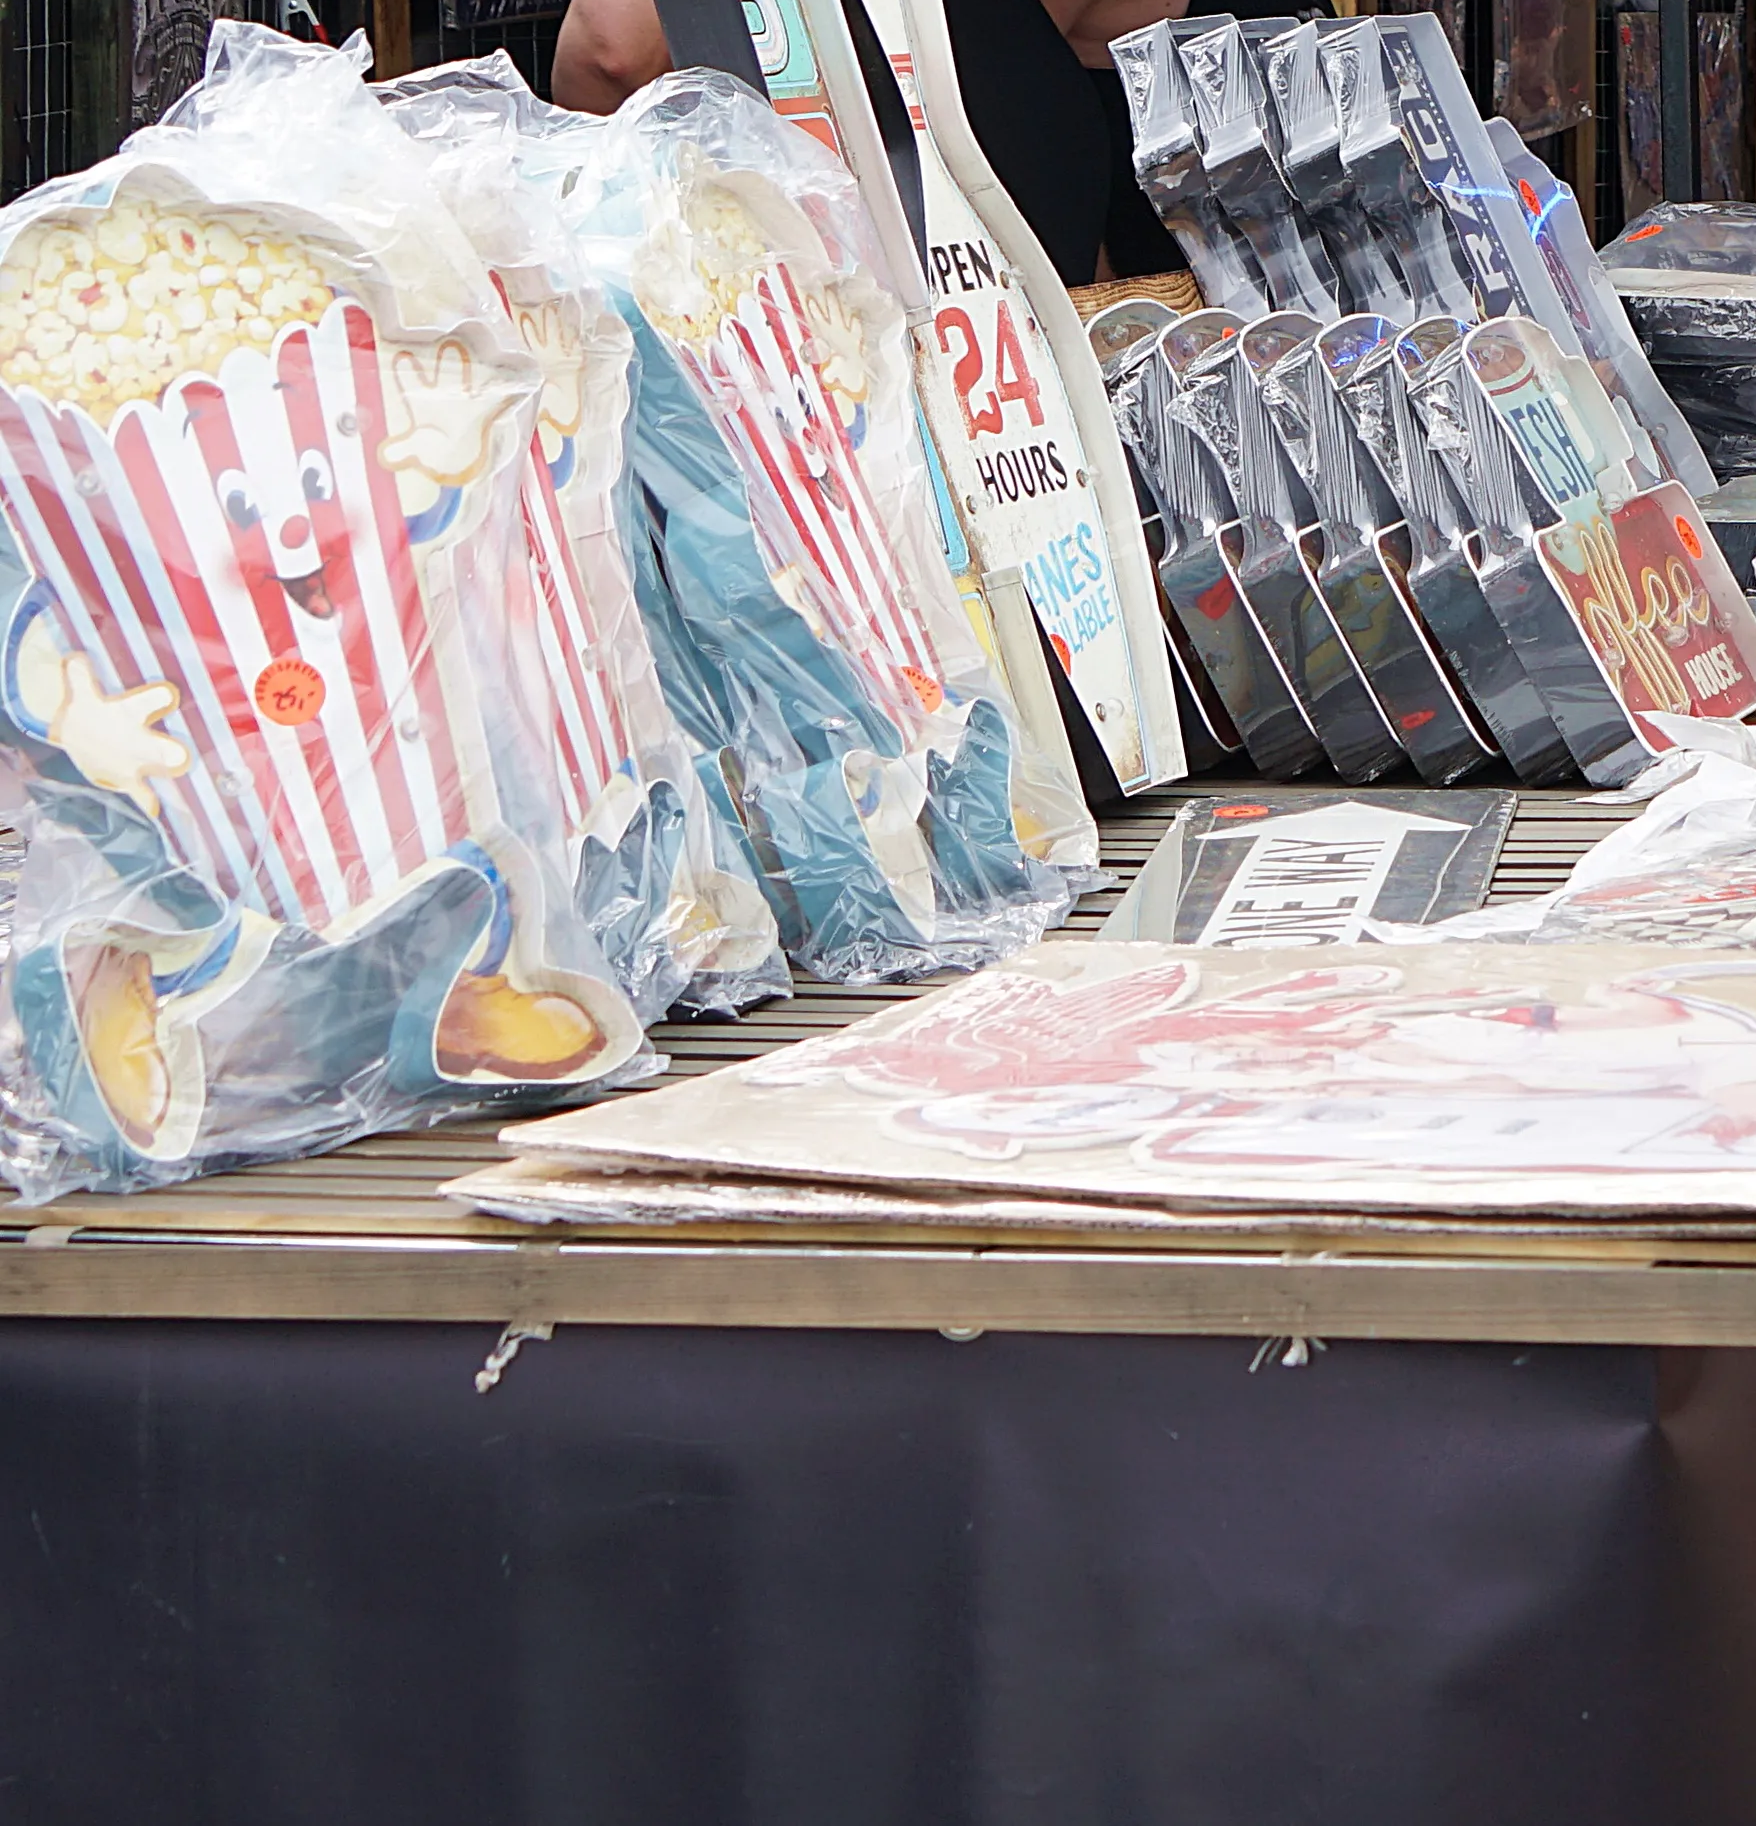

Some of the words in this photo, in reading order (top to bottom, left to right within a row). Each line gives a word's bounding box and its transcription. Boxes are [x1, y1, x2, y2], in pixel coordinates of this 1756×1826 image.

[930, 239, 992, 298] PEN
[933, 300, 1043, 440] 24
[975, 441, 1069, 507] HOURS
[1683, 643, 1744, 702] HOUSE
[1243, 836, 1384, 890] WAY
